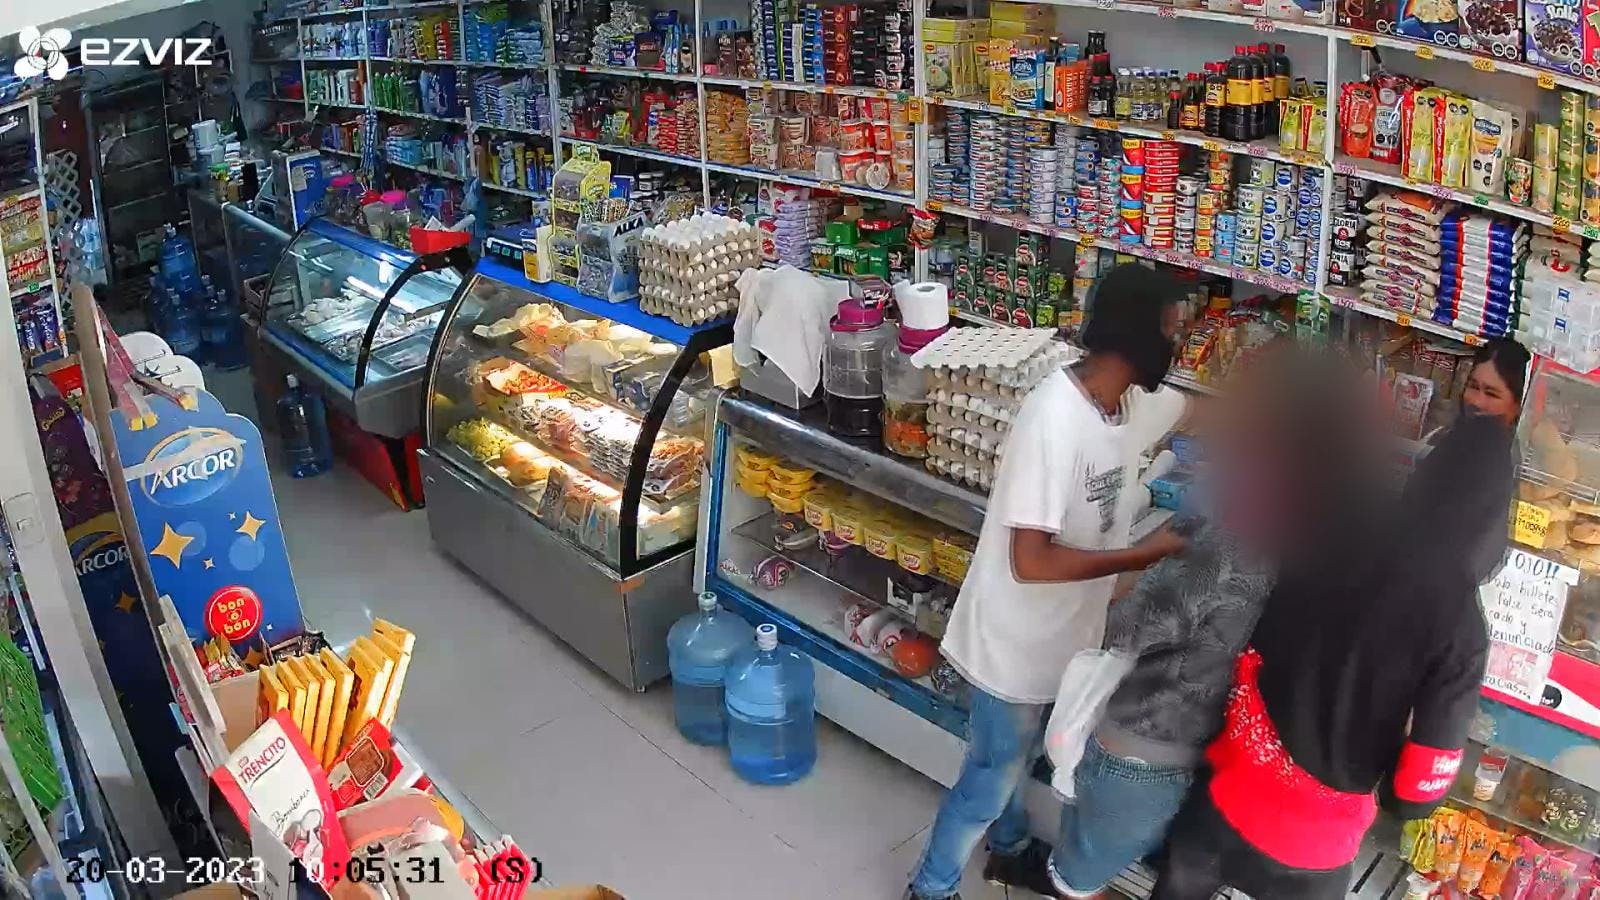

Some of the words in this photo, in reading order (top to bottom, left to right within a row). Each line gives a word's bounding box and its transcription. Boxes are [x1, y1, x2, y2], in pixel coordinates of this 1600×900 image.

[613, 215, 644, 238] ALKA
[150, 448, 236, 495] ARCOR
[217, 597, 245, 613] bon
[223, 617, 251, 635] bon
[238, 736, 286, 784] TRENCITO
